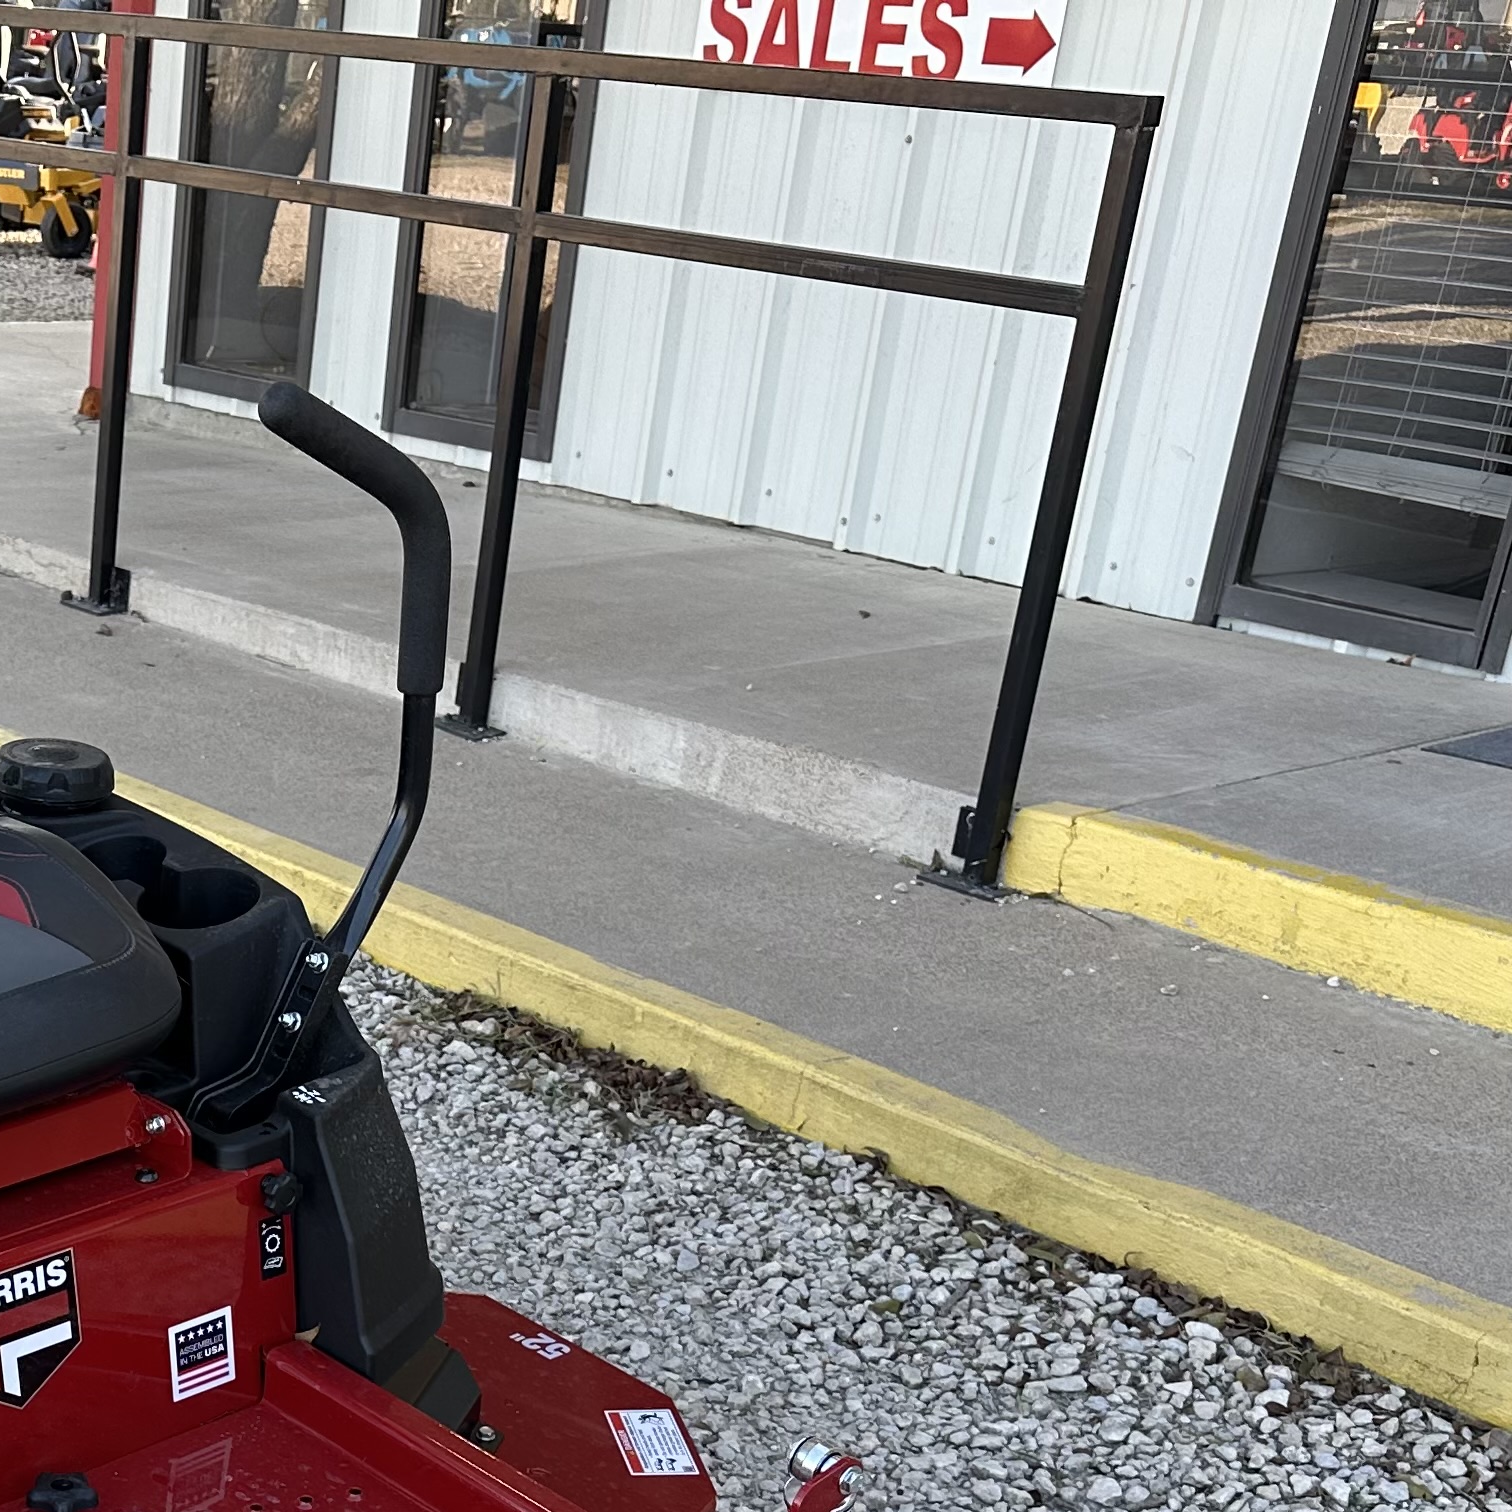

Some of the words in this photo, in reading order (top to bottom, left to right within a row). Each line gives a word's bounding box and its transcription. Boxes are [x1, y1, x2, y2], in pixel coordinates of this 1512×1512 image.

[703, 0, 969, 80] SALES
[179, 1333, 224, 1357] ASSEMBLED
[180, 1357, 188, 1367] IN
[189, 1351, 203, 1363] THE
[204, 1342, 225, 1358] USA
[509, 1332, 571, 1360] 52"
